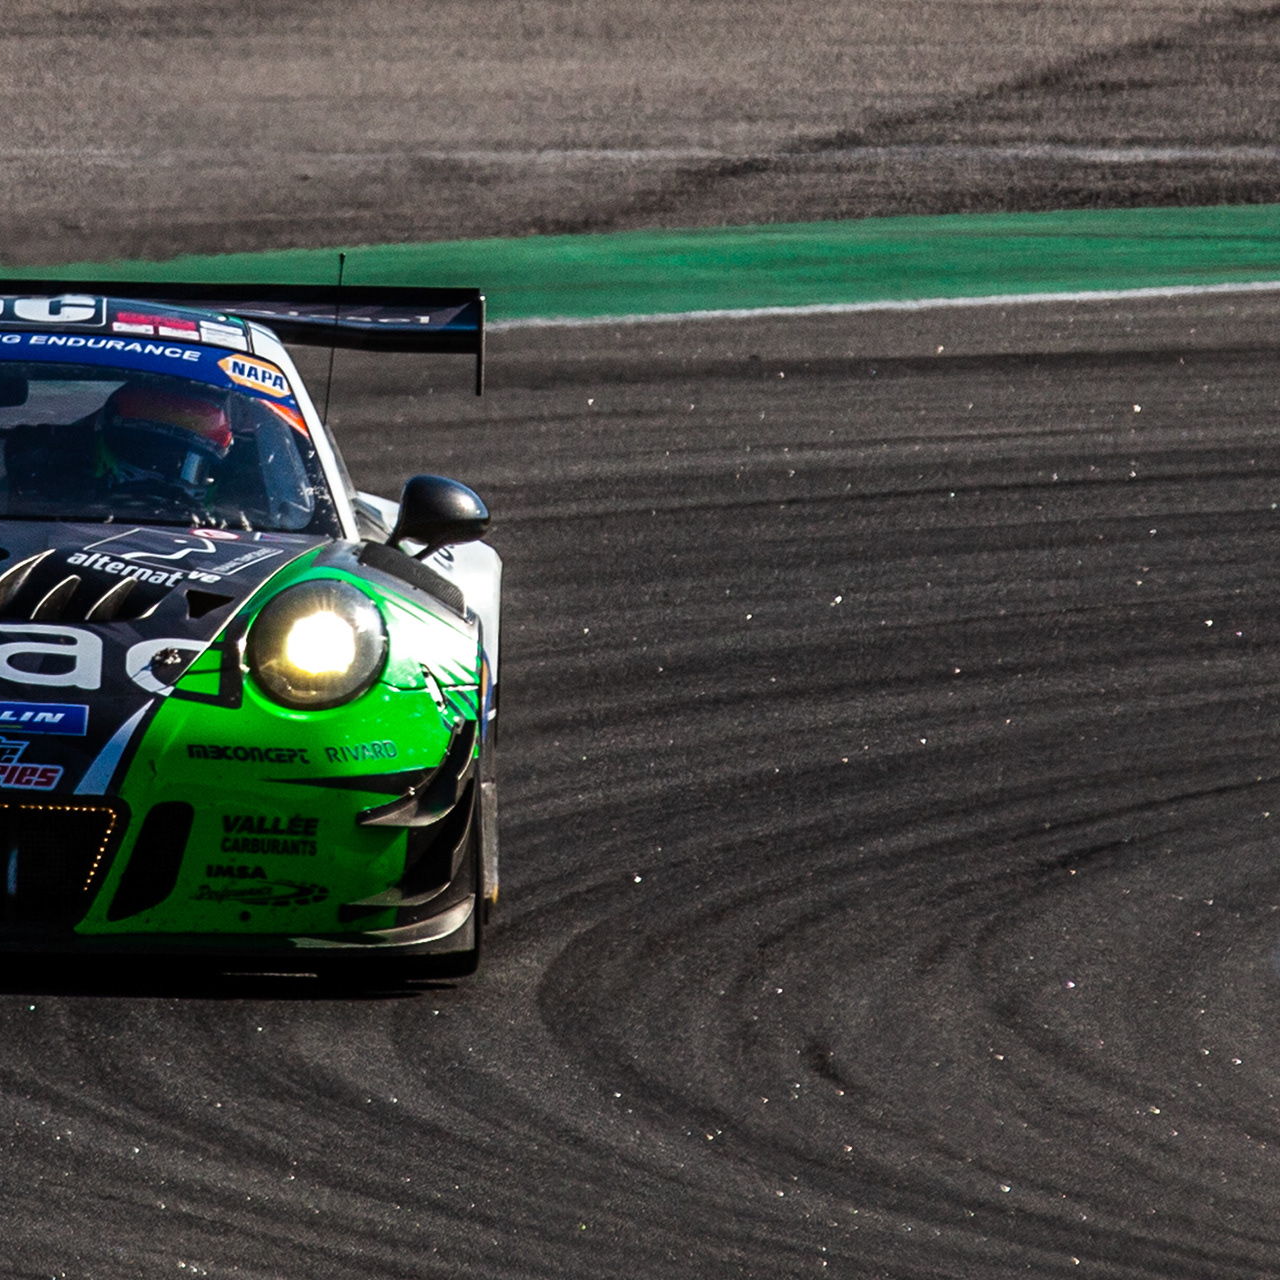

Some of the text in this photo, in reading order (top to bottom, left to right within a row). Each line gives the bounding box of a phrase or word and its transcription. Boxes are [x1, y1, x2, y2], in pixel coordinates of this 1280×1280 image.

[29, 335, 202, 362] ENDURANCE
[231, 360, 285, 391] NAPA
[325, 740, 398, 763] RIVARD
[222, 813, 320, 836] VALLÉE
[221, 836, 318, 857] CARBURANTS
[206, 864, 267, 880] IMSA
